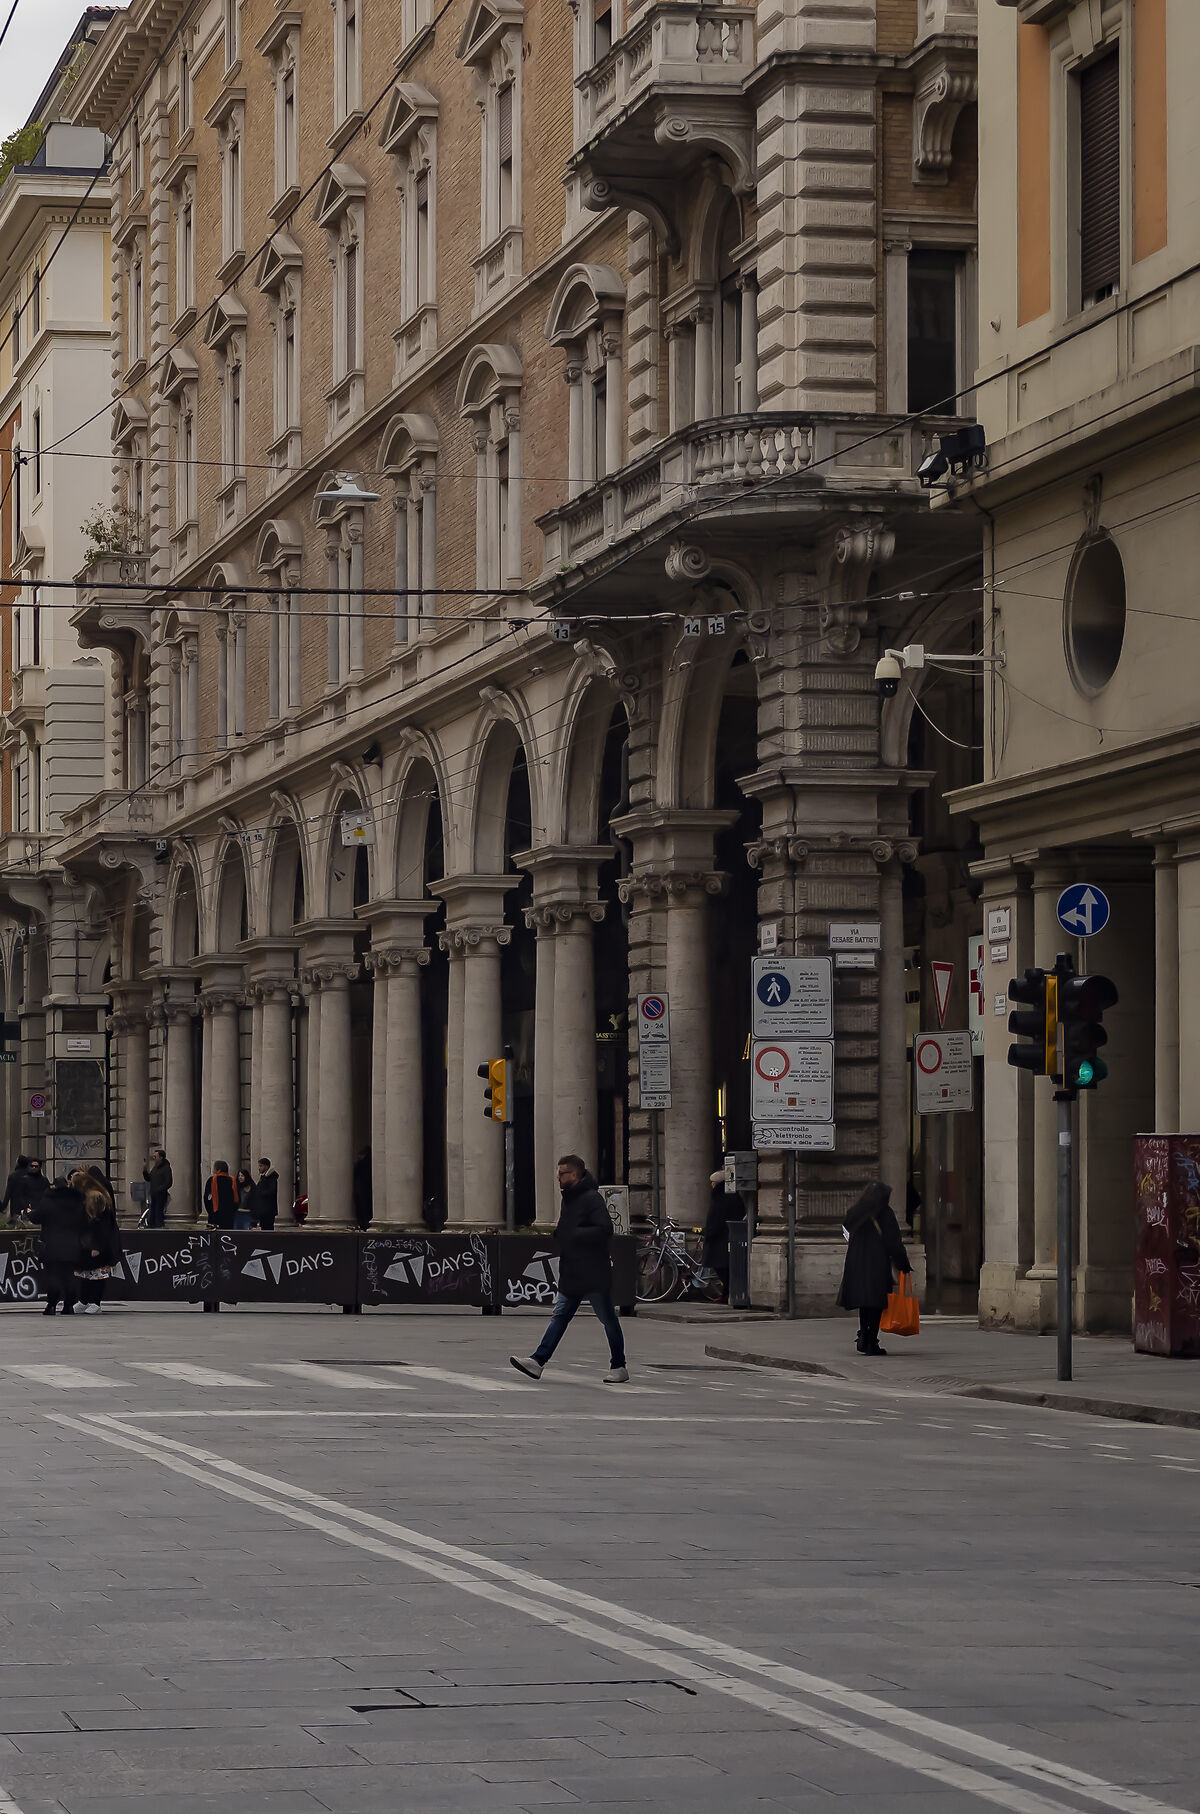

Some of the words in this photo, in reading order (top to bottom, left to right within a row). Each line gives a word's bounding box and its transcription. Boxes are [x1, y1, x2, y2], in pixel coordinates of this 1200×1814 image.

[555, 629, 568, 639] 13
[685, 624, 699, 634] 14
[831, 936, 854, 944] CESARE
[854, 936, 879, 944] BATTISTI
[144, 1248, 193, 1275] DAYS
[286, 1251, 335, 1276] DAYS
[427, 1251, 476, 1278] DAYS
